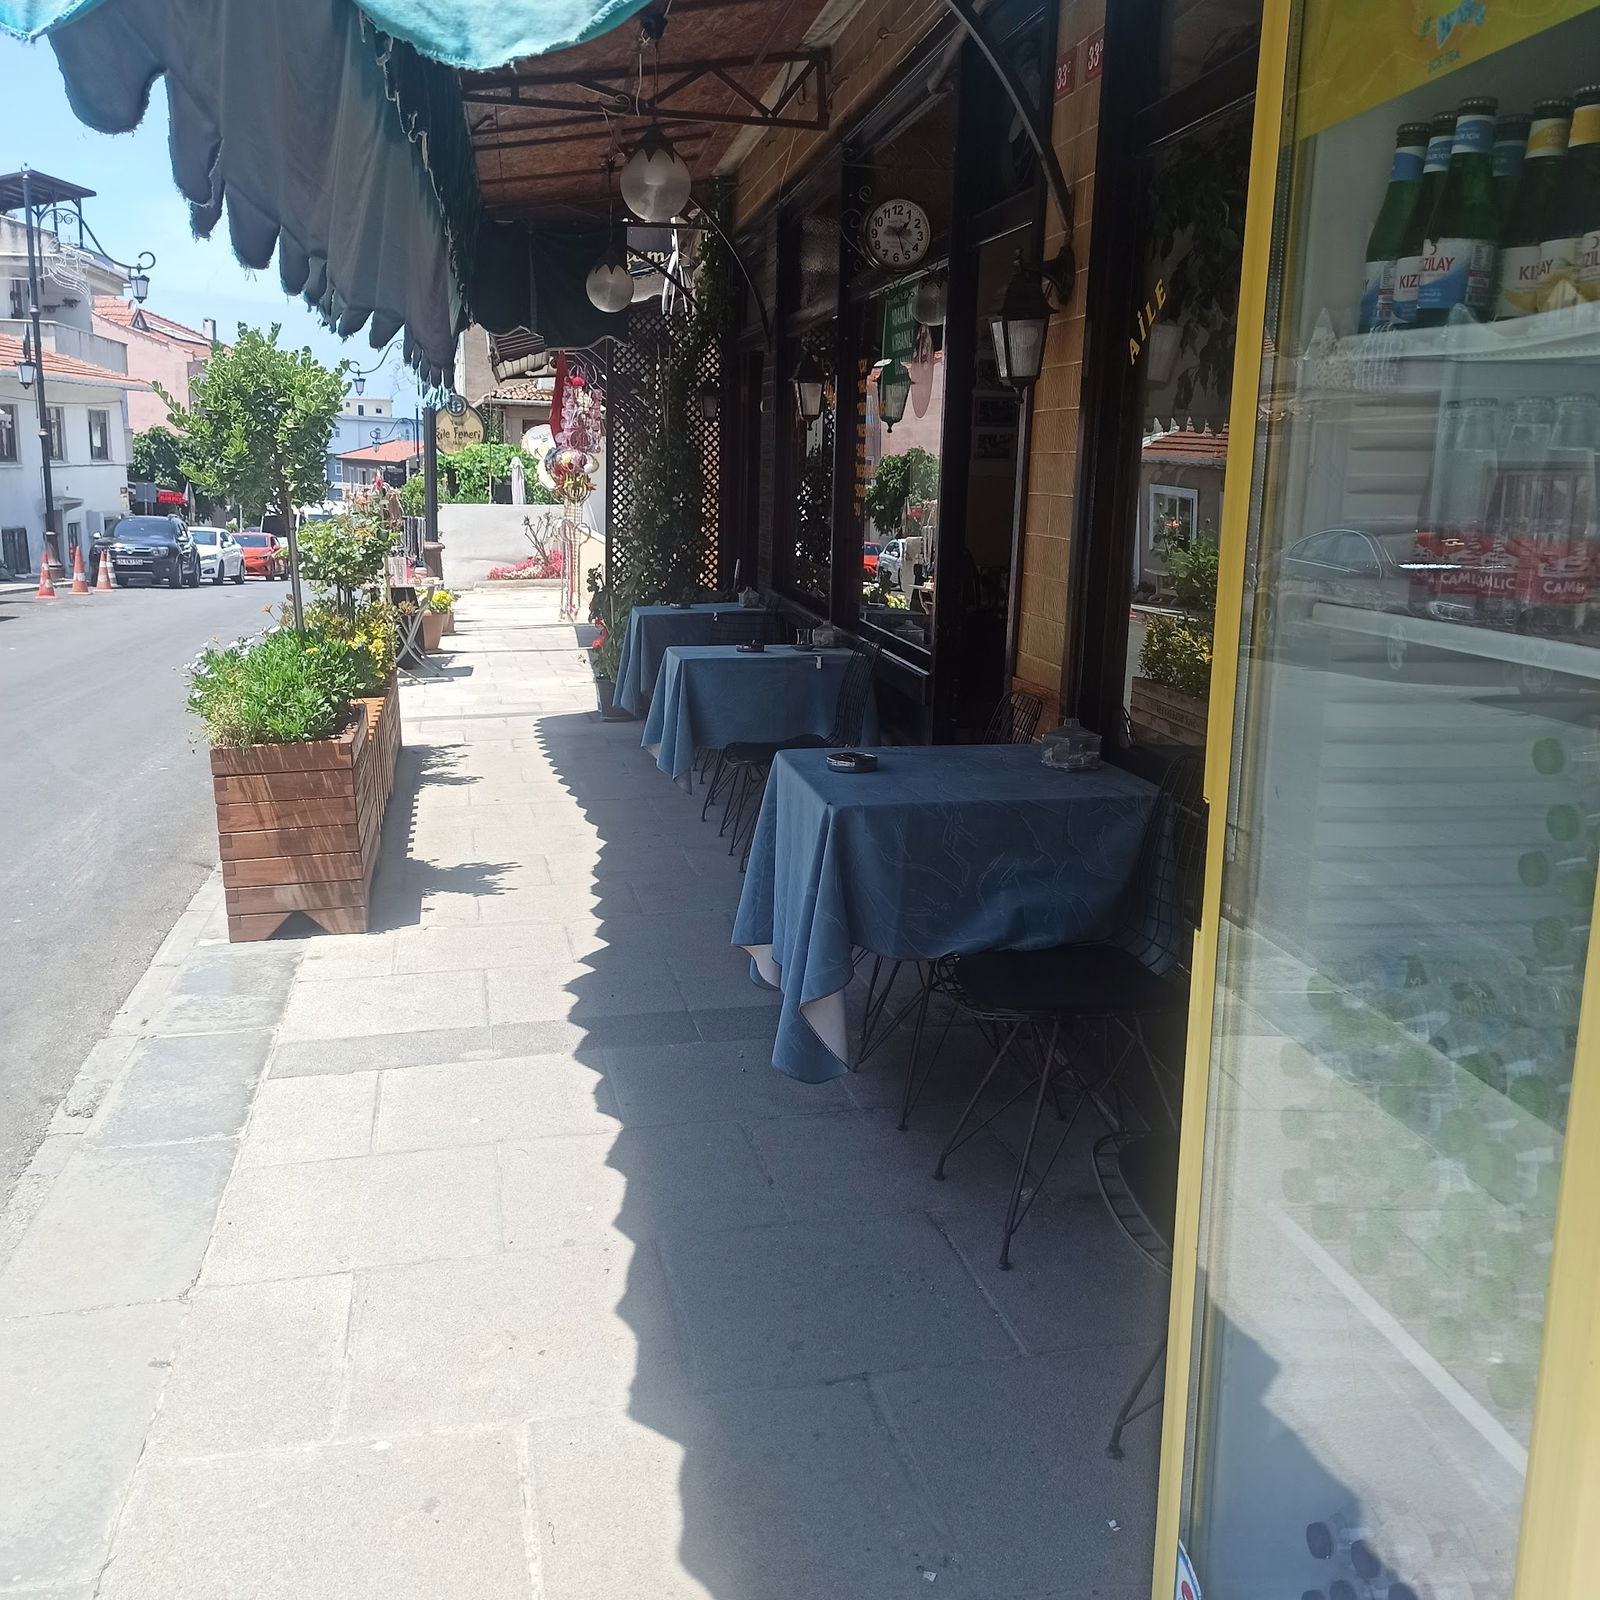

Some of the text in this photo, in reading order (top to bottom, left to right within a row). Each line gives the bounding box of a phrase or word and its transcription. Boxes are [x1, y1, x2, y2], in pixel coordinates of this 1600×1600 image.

[882, 208, 891, 218] 11
[891, 205, 904, 215] 12
[906, 209, 912, 219] 1
[873, 217, 883, 227] 10
[914, 219, 921, 229] 2
[871, 229, 878, 239] 9
[917, 231, 923, 241] 3
[875, 240, 881, 250] 8
[912, 243, 919, 252] 4
[882, 249, 889, 258] 7
[893, 252, 899, 262] 6
[904, 251, 911, 260] 5
